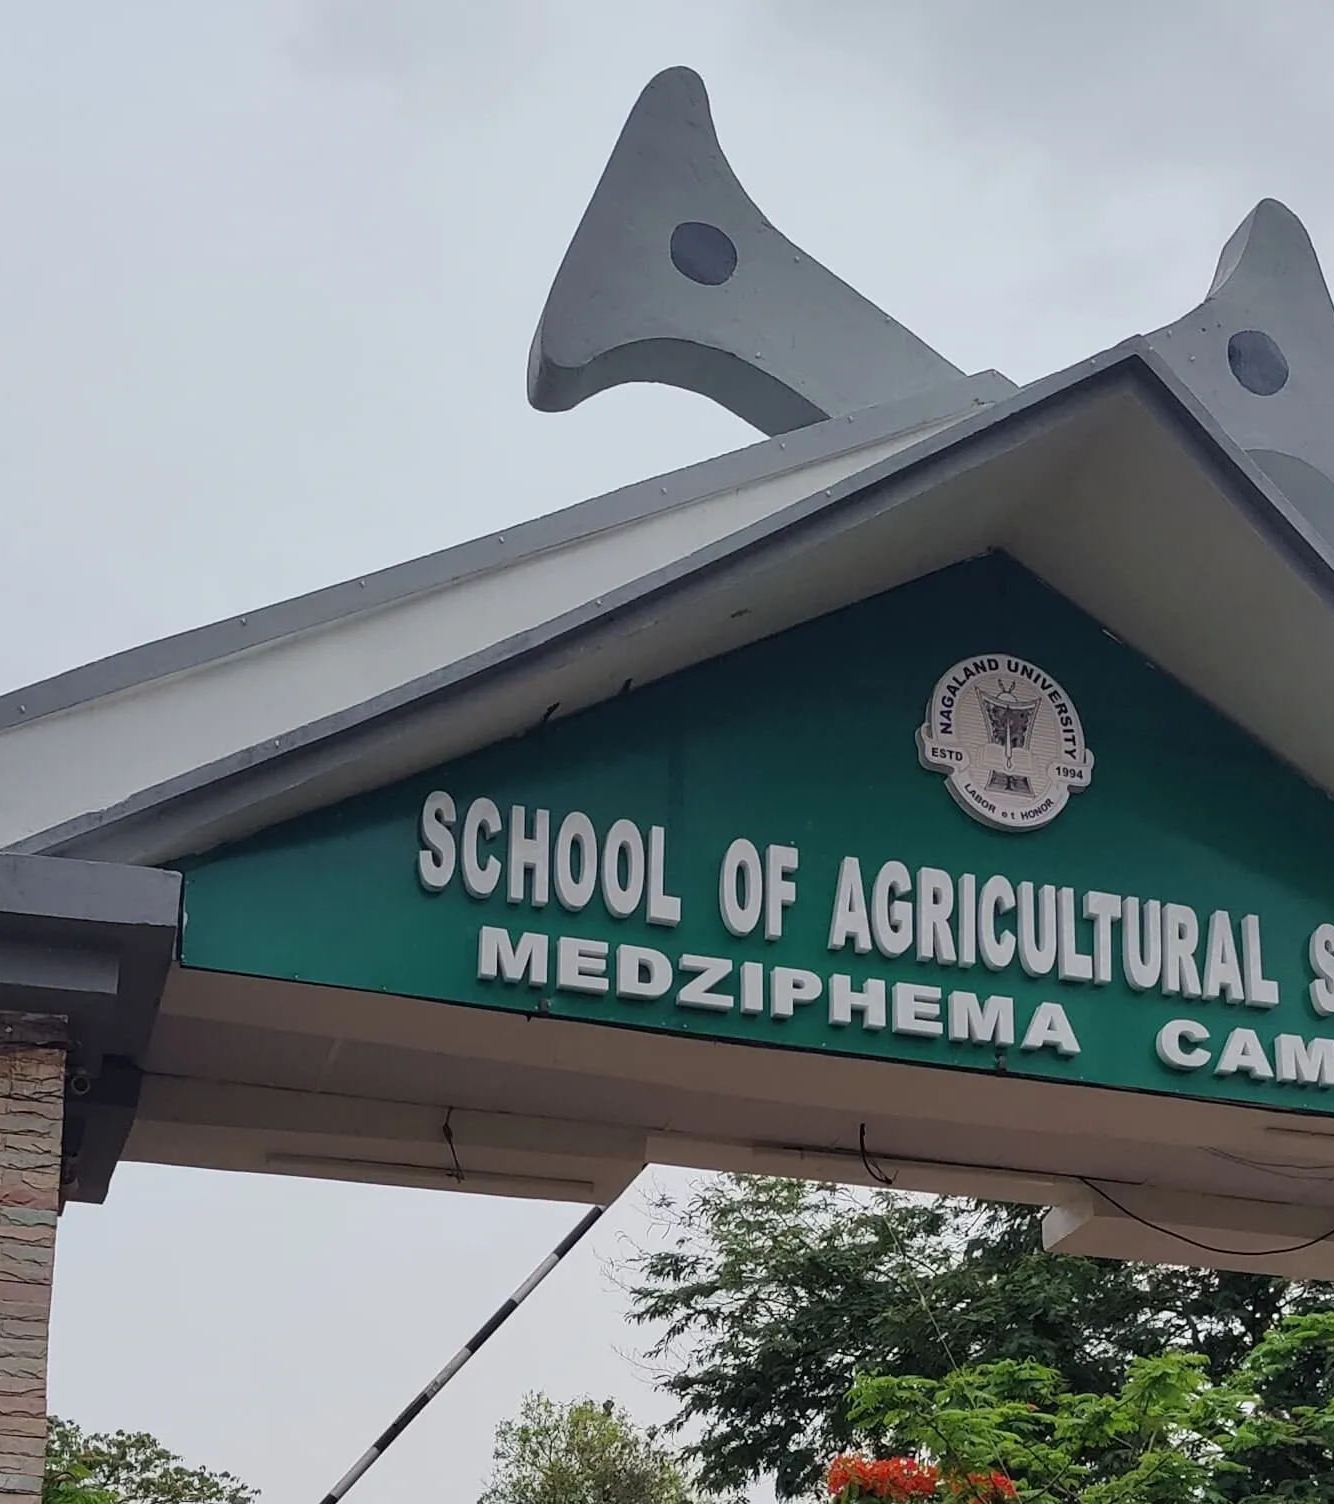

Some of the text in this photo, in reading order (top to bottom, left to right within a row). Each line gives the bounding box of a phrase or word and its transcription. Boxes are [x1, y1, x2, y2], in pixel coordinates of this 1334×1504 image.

[940, 658, 1077, 760] NAGALAND UNIVERSITY
[931, 747, 963, 762] ESTD
[1055, 766, 1084, 780] 1994
[964, 783, 1054, 821] LABOR et HONOR
[416, 791, 681, 927] SCHOOL
[718, 837, 799, 943] OF
[826, 855, 1280, 1009] AGRICULTURAL
[476, 925, 1082, 1056] MEDZIPHEMA
